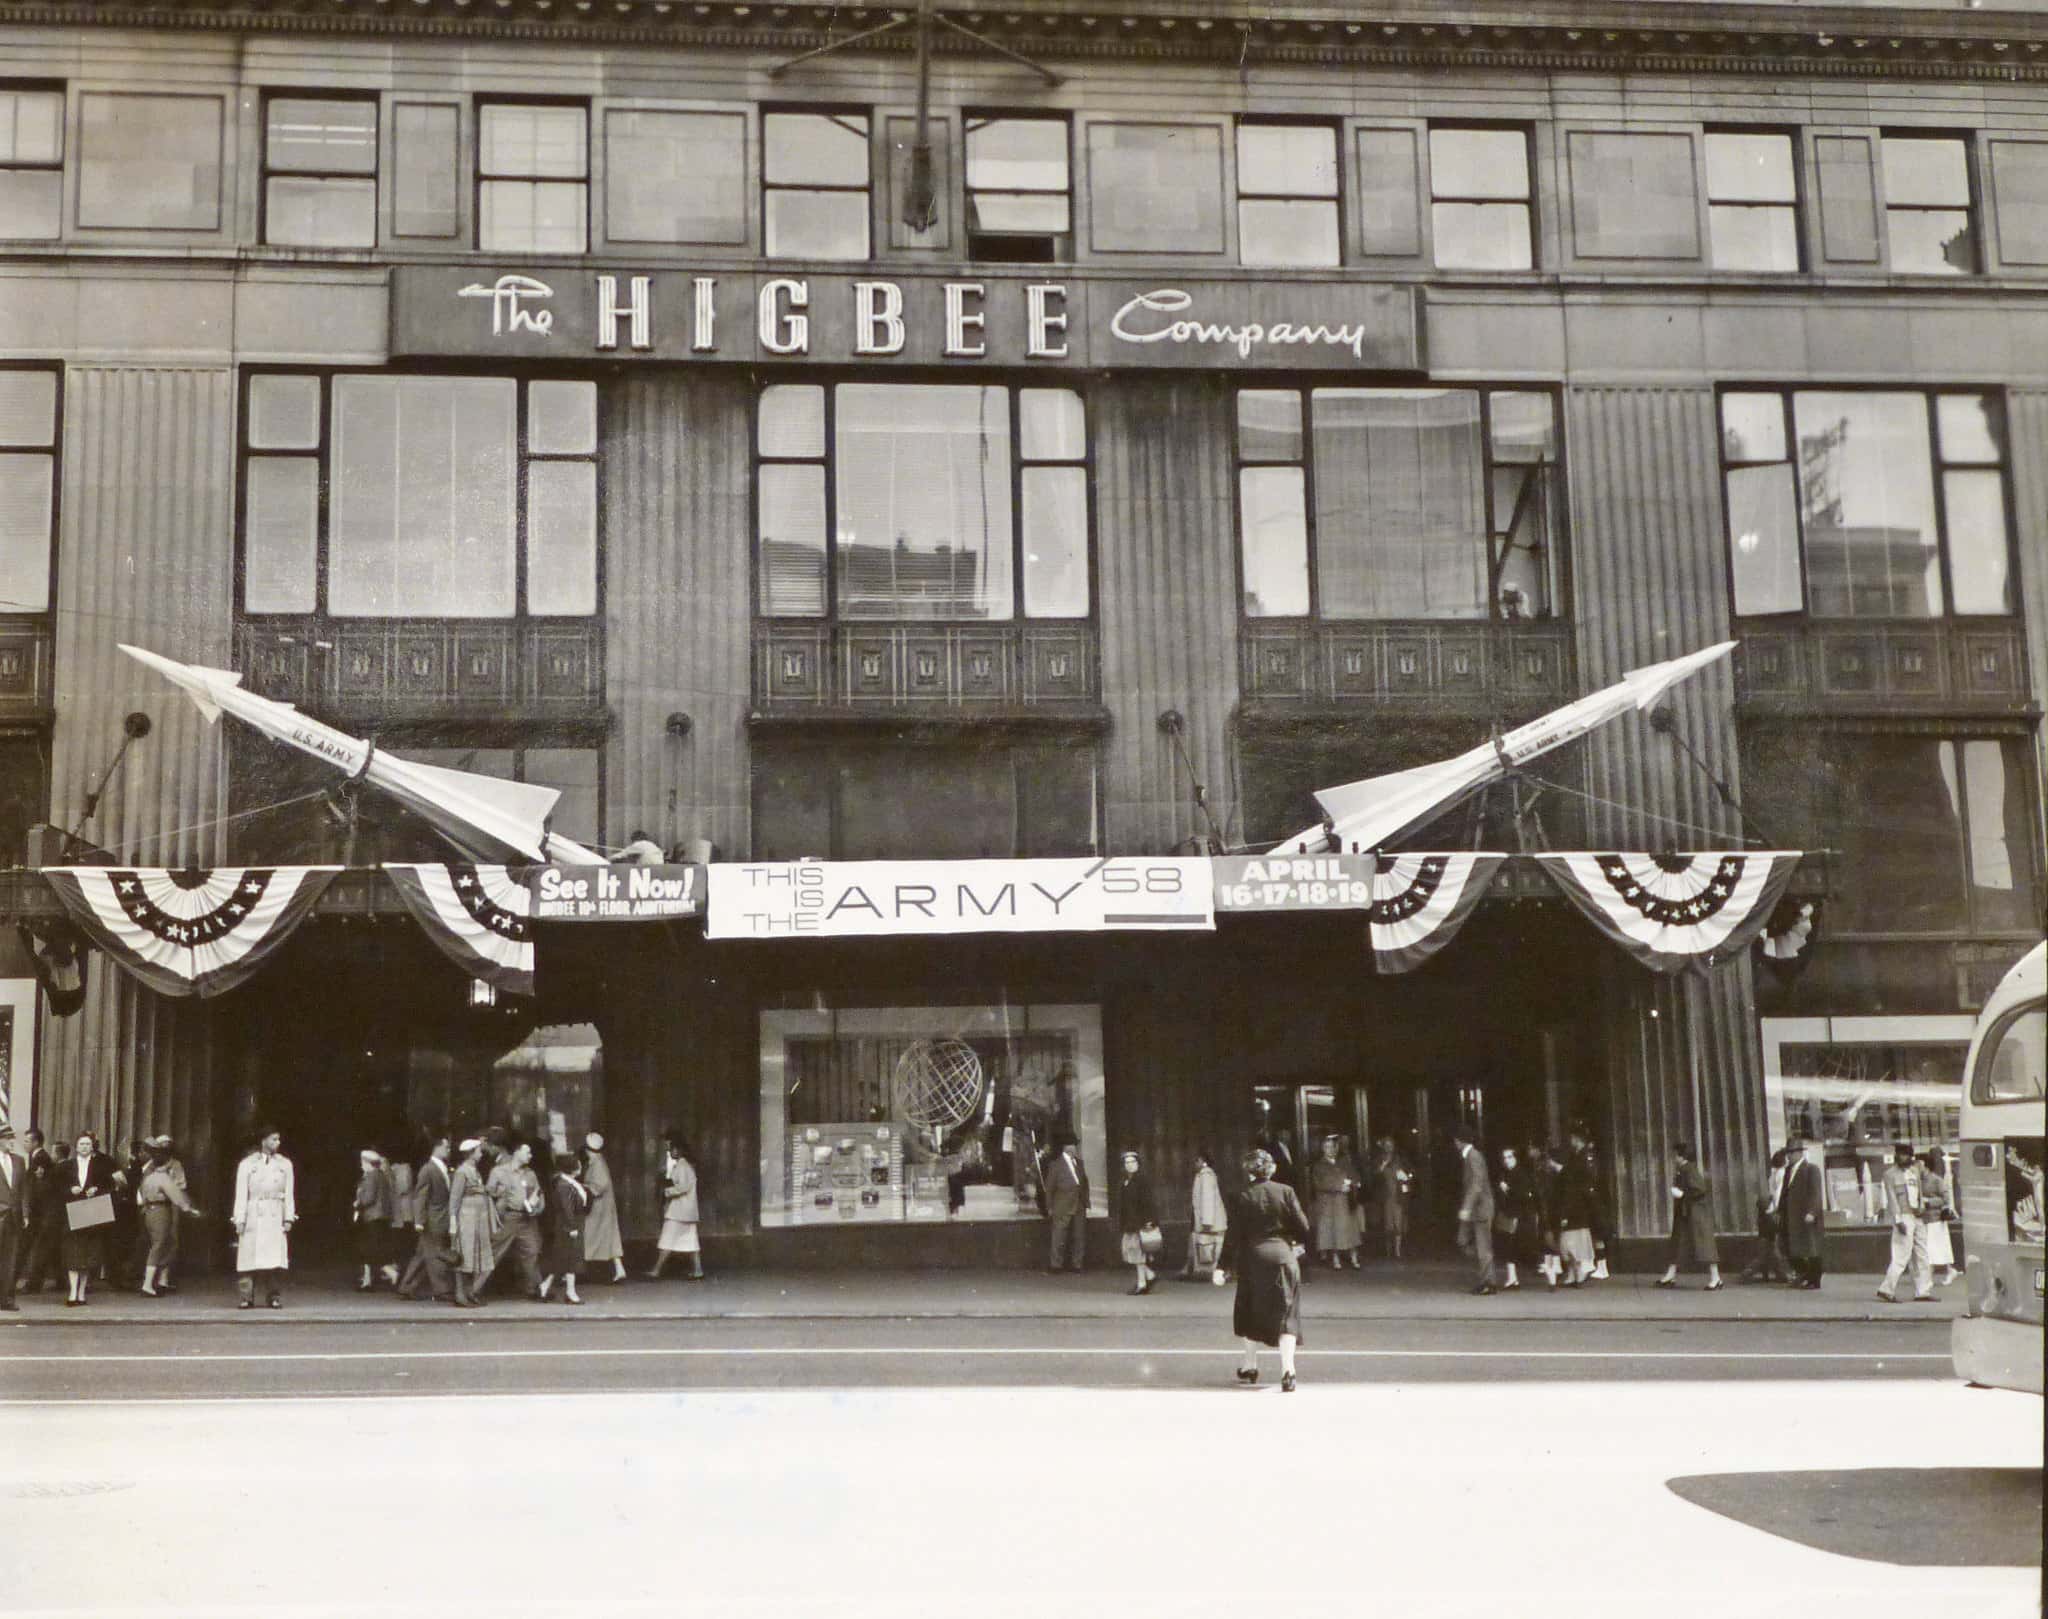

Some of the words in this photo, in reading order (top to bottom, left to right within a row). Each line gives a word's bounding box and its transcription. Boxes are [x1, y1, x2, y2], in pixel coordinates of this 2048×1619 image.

[457, 275, 554, 336] The
[596, 276, 1068, 357] HIGBEE
[1111, 289, 1365, 360] Company
[316, 740, 354, 764] ARMY
[742, 867, 824, 887] THIS
[1241, 859, 1350, 881] APRIL
[540, 868, 588, 900] See
[598, 867, 621, 899] It
[629, 867, 694, 900] Now!
[794, 889, 824, 909] IS
[826, 882, 1082, 920] ARMY
[743, 911, 819, 931] THE
